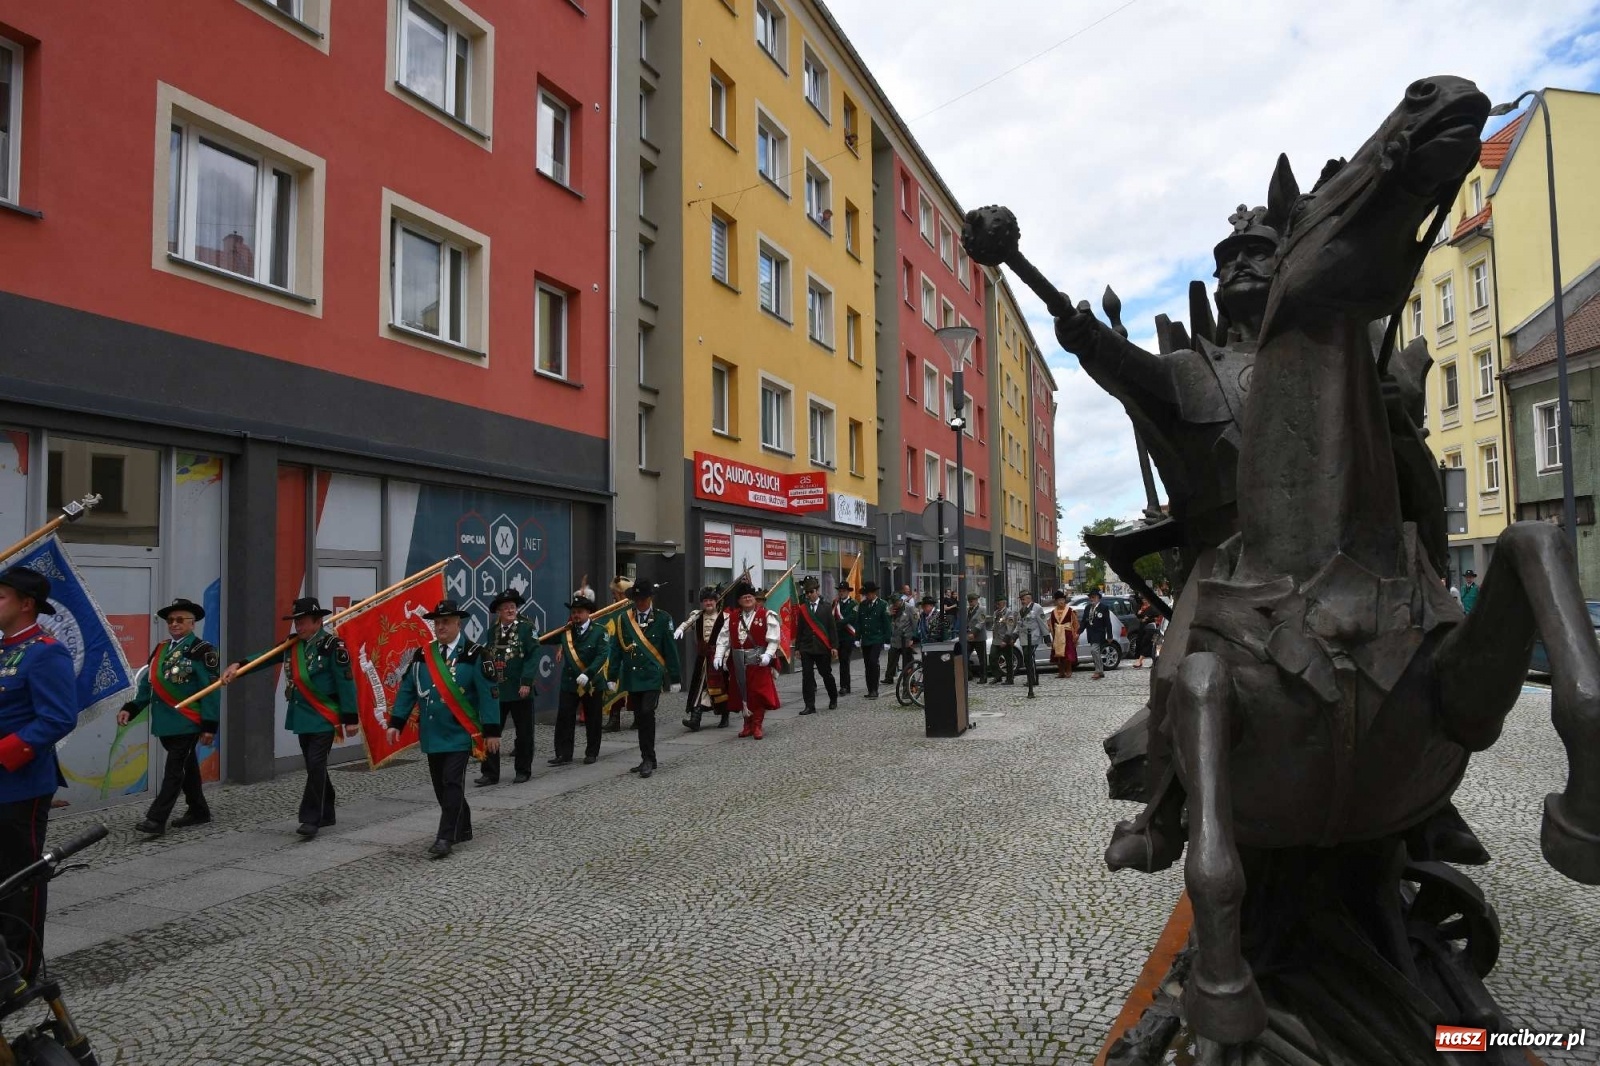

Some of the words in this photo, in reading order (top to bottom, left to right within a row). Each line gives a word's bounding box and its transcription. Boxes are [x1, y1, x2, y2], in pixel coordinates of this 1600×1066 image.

[702, 460, 724, 495] as
[725, 465, 780, 491] AUDIO-SŁUCH
[461, 534, 475, 544] OPC
[475, 535, 486, 545] UA
